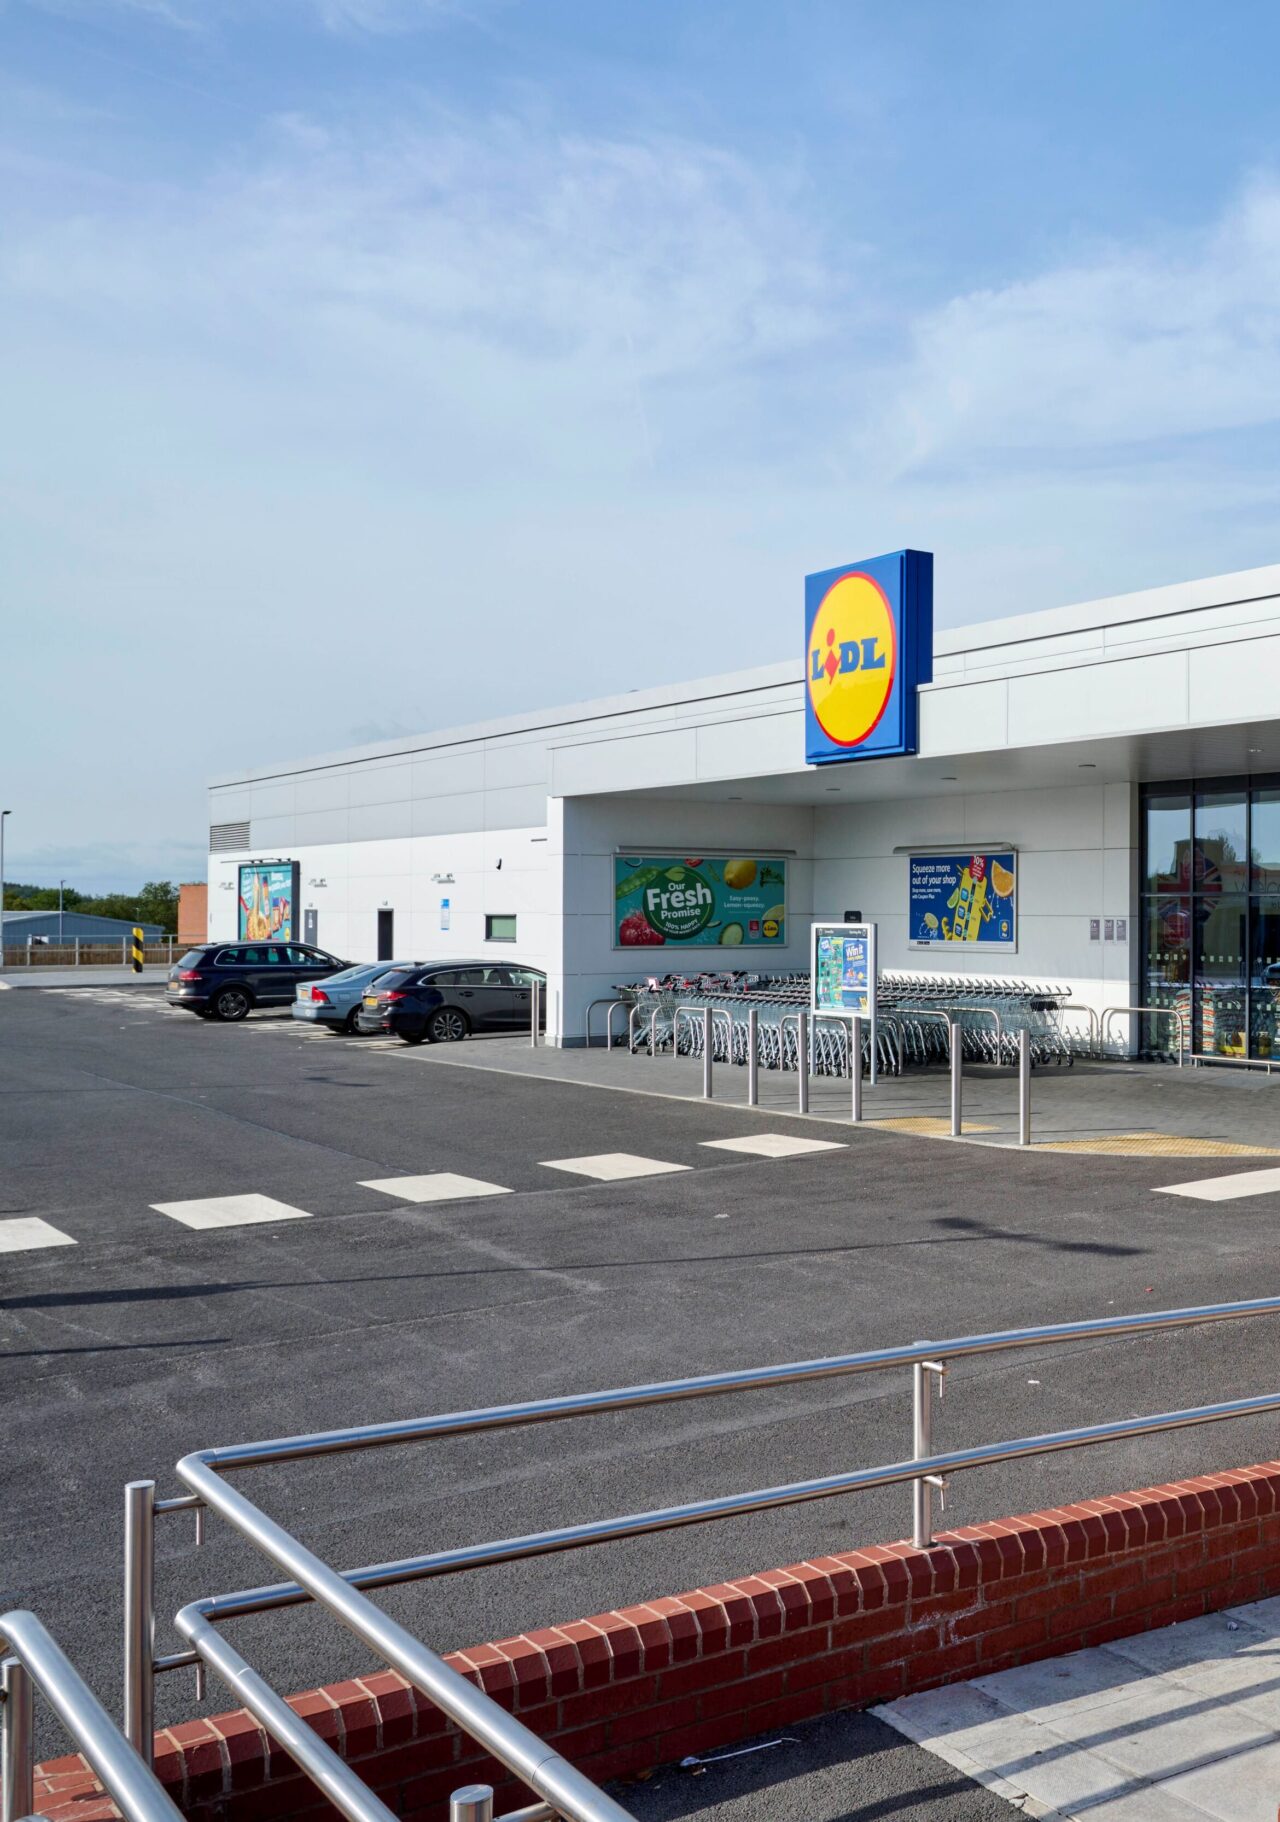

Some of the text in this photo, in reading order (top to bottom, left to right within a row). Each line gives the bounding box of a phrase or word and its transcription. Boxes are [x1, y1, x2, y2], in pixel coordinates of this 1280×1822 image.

[912, 863, 951, 875] Squeeze more
[668, 882, 686, 891] Our
[912, 874, 957, 887] out of your shop
[646, 882, 712, 911] Fresh
[660, 906, 701, 920] Promise
[665, 918, 698, 931] 100% HAPPY
